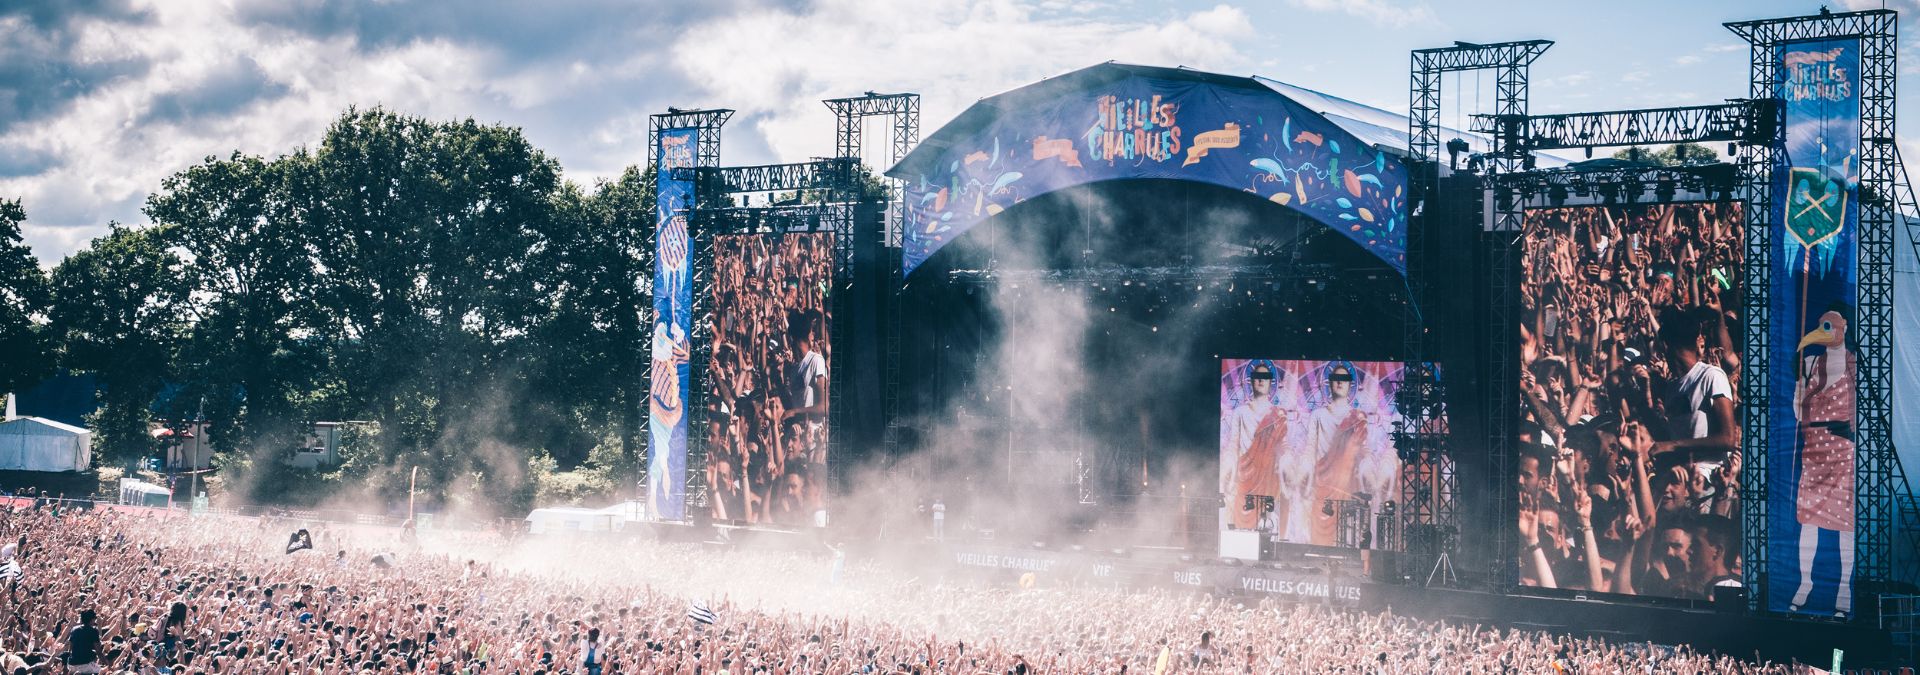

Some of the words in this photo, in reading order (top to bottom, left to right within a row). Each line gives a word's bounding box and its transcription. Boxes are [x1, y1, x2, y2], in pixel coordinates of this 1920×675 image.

[1088, 126, 1181, 163] CHARRUES
[957, 551, 998, 567] VIEILLES
[1242, 576, 1293, 594] VIEILLES
